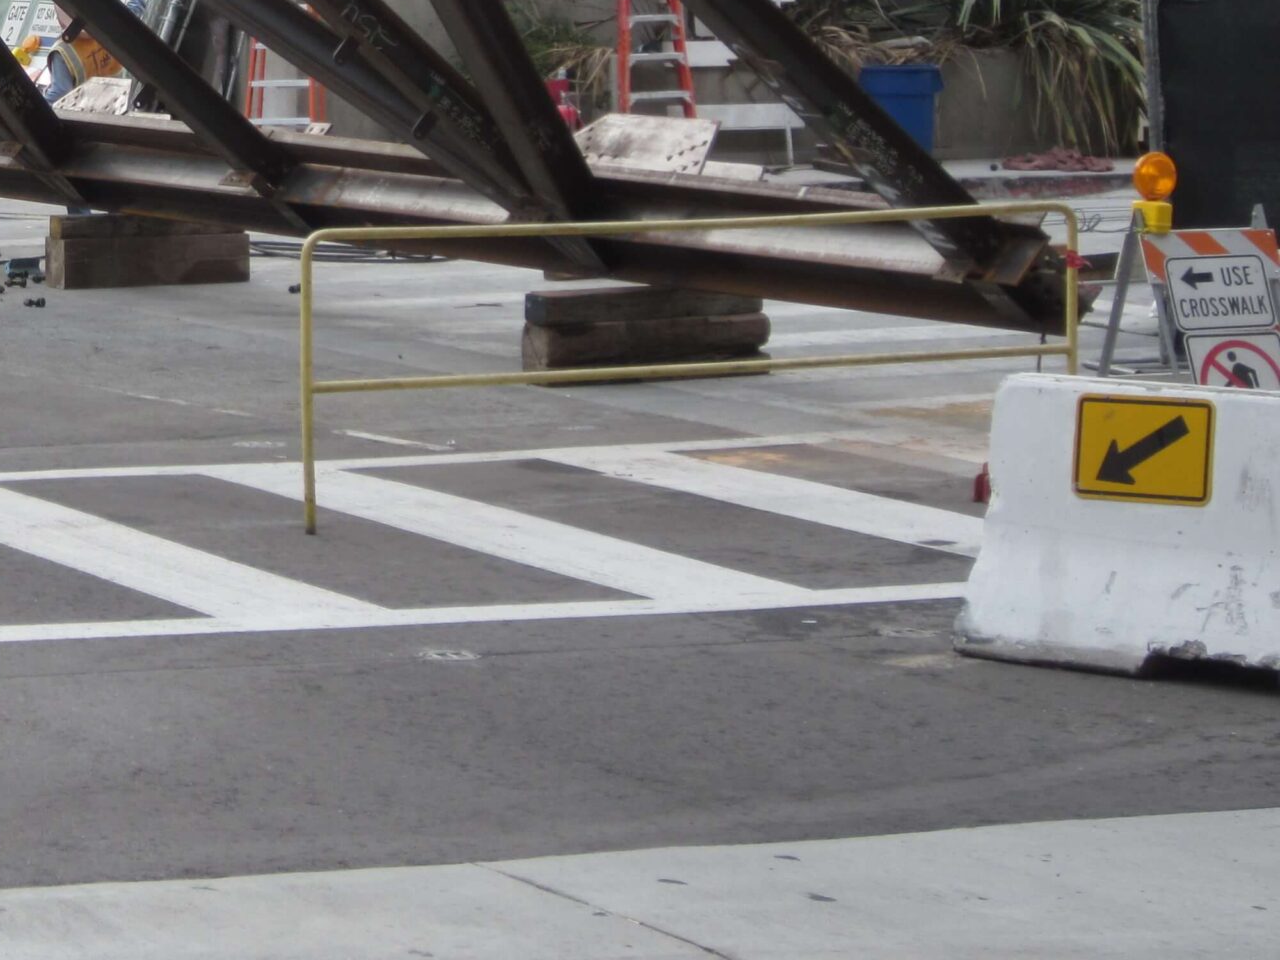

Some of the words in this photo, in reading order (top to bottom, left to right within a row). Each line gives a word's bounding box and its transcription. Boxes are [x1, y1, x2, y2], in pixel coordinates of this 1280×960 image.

[8, 5, 28, 21] GATE
[5, 26, 14, 42] 2
[1220, 265, 1253, 287] USE
[1179, 295, 1269, 319] CROSSWALK
